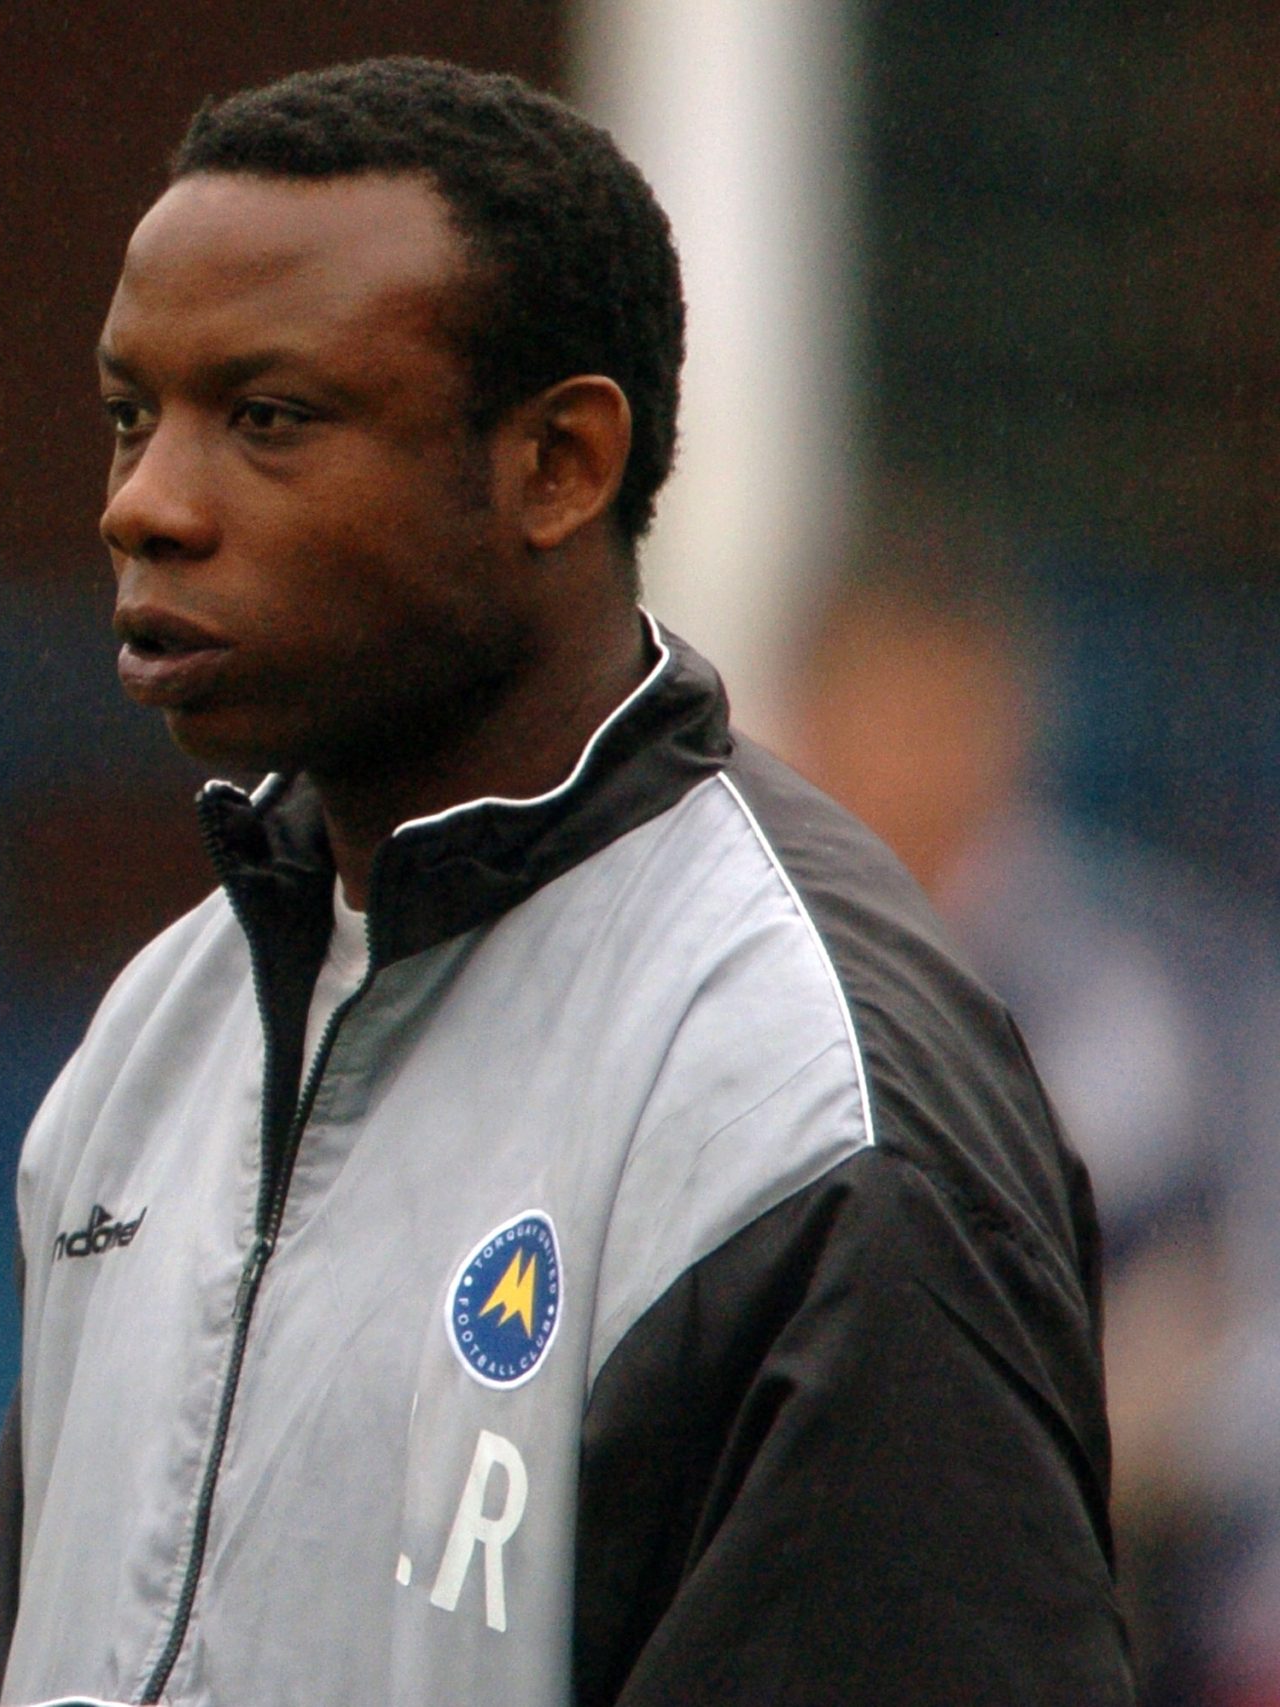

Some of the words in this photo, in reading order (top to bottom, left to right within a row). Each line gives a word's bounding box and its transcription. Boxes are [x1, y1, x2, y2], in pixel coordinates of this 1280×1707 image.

[474, 1223, 539, 1269] TORQUAY
[538, 1229, 557, 1294] UNITED
[457, 1297, 517, 1377] FOOTBALL
[519, 1319, 552, 1370] CLUB
[395, 1428, 529, 1633] R
